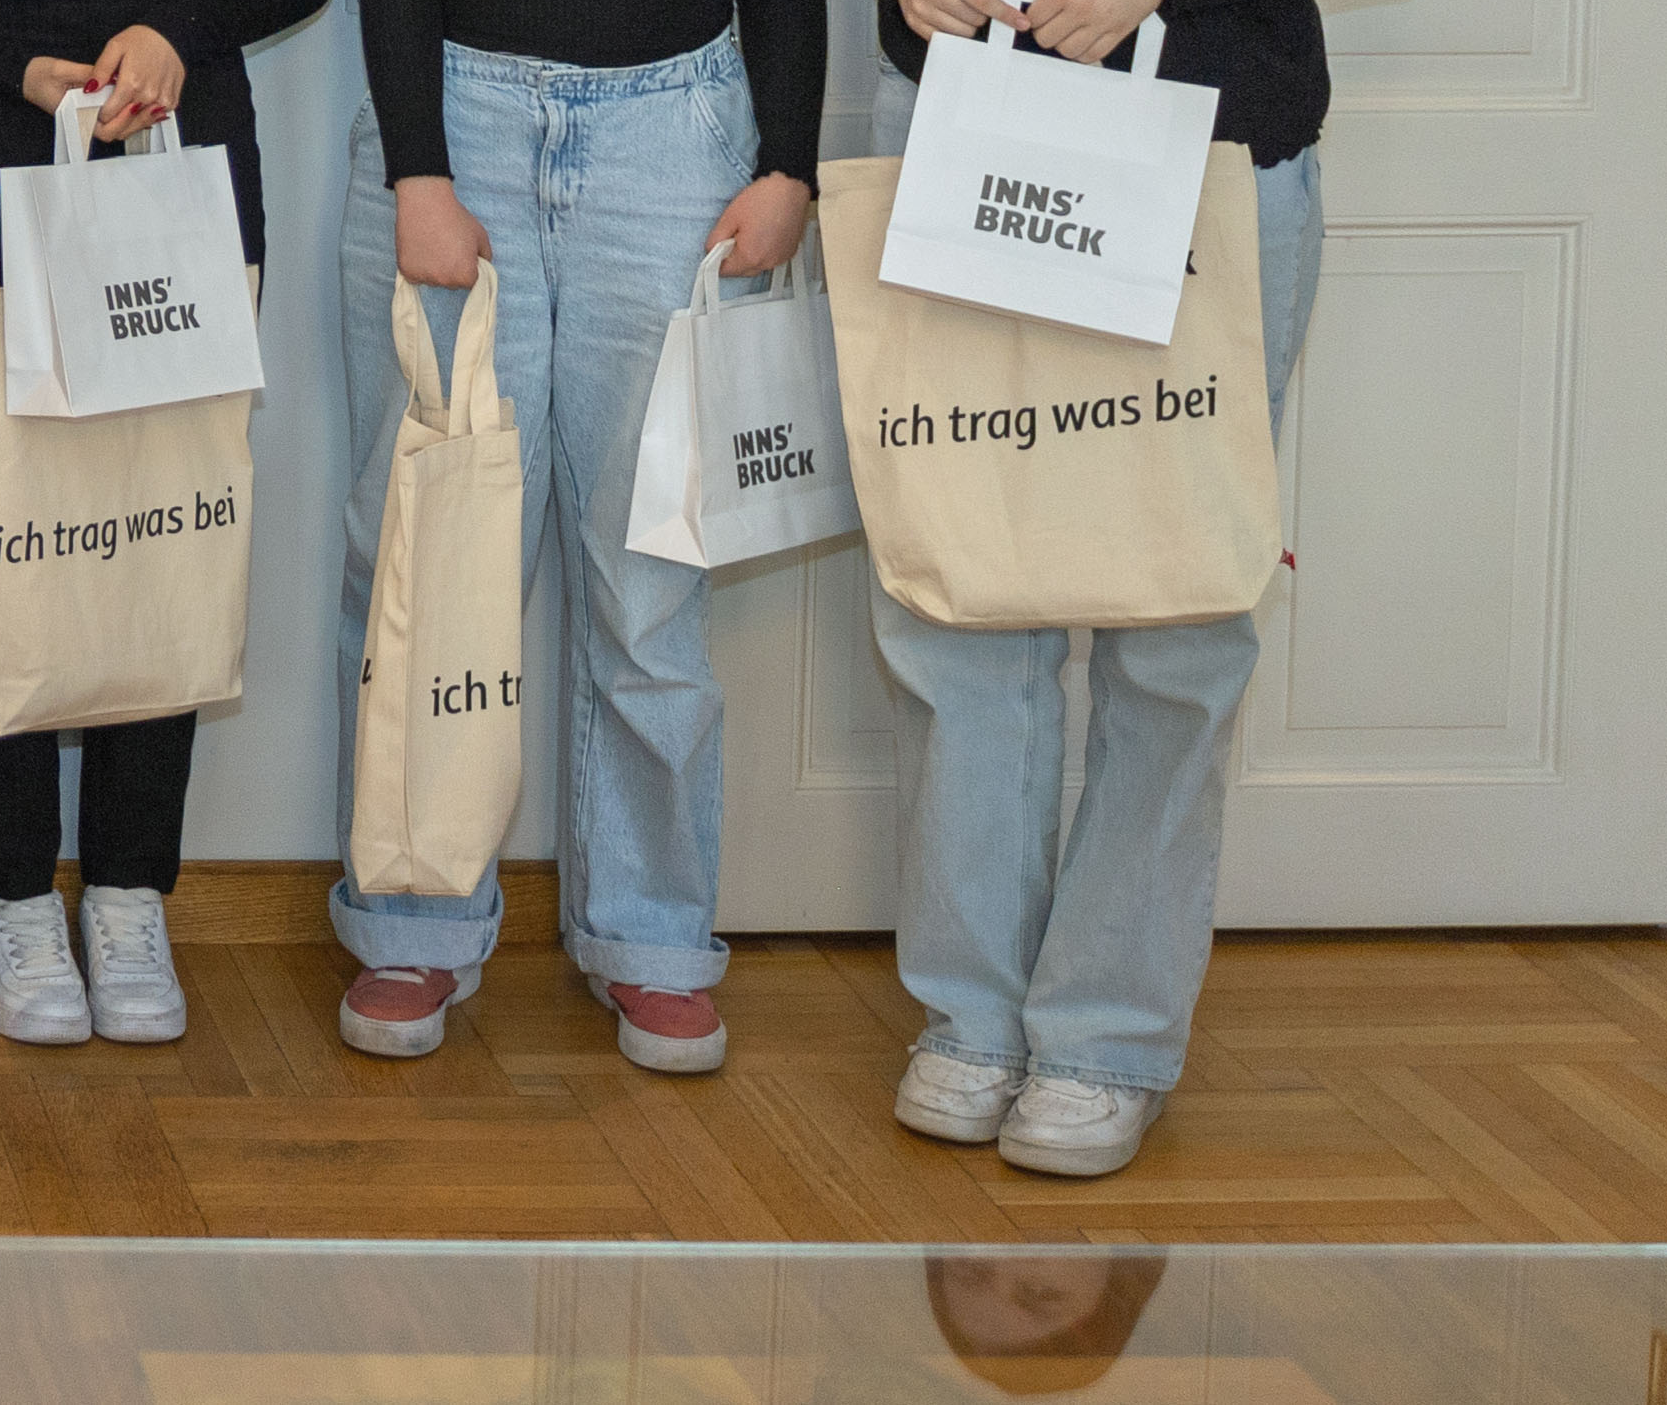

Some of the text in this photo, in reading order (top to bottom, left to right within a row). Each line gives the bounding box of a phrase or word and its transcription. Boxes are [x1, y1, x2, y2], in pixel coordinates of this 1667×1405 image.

[979, 173, 1085, 217] INNS'
[973, 203, 1107, 257] BRUCK
[104, 276, 172, 311] INNS'
[109, 303, 201, 340] BRUCK
[878, 374, 1218, 451] ich trag was bei
[732, 422, 793, 461] INNS'
[736, 448, 816, 490] BRUCK
[53, 518, 118, 561] trag
[125, 505, 184, 543] was
[194, 484, 236, 531] bei
[431, 669, 488, 717] ich
